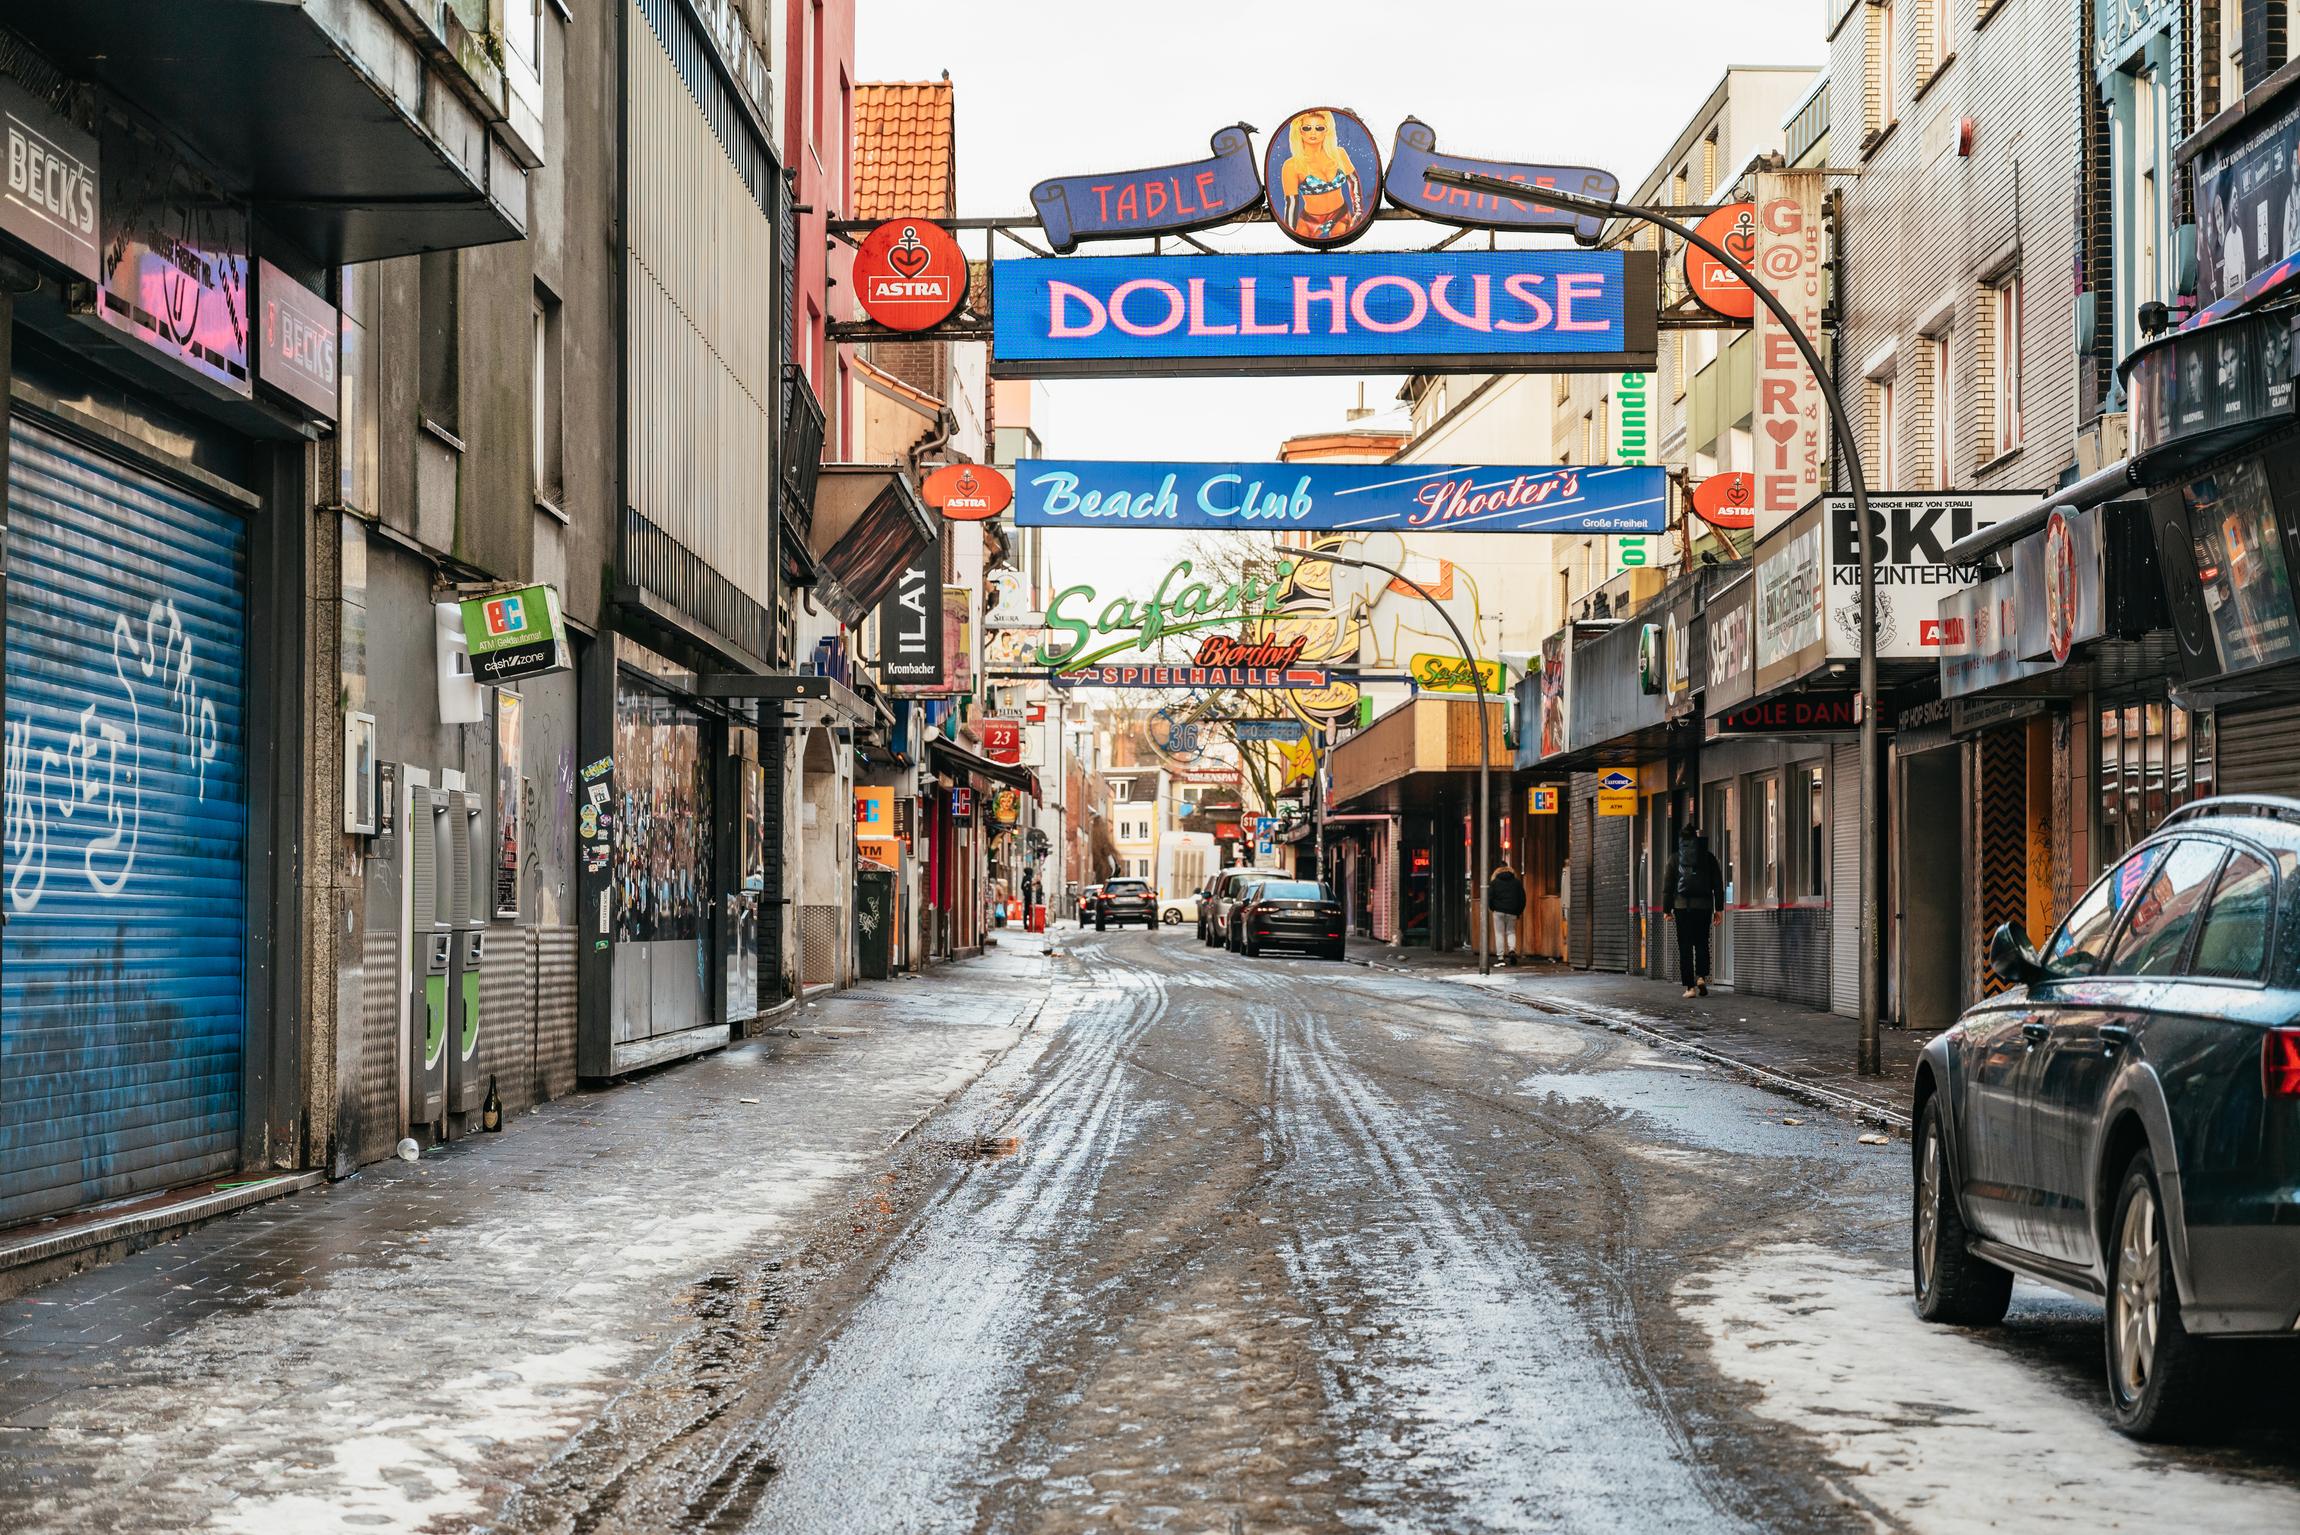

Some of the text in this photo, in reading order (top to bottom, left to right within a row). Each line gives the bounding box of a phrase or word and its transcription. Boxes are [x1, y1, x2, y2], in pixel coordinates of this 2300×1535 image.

[8, 128, 95, 235] BECK'S
[1091, 171, 1225, 223] TABLE
[1803, 226, 1818, 297] CLUB
[874, 281, 943, 297] ASTRA
[1047, 273, 1611, 339] DOLLHOUSE
[281, 310, 335, 385] BECK'S
[2268, 382, 2292, 396] YELLOW
[1804, 403, 1818, 421] &
[2271, 396, 2289, 408] CLAW
[1803, 431, 1818, 484] BAR
[947, 498, 987, 508] ASTRA
[1031, 470, 1313, 522] Beach Club
[1582, 518, 1649, 529] Große Freiheit
[899, 566, 927, 654] ILAY
[1035, 558, 1294, 667] Safari
[479, 631, 543, 651] ATM Geldautomat
[1194, 632, 1308, 674] Bierdorf
[888, 661, 935, 675] Krombacher
[1102, 666, 1281, 686] SPIELHALLE
[1728, 703, 1788, 727] OLE
[1910, 705, 1924, 728] HOP
[1924, 698, 1945, 725] SINCE
[992, 731, 1011, 745] 23
[1169, 723, 1198, 752] 36
[1293, 748, 1313, 768] 36
[1603, 777, 1629, 786] Euronet
[1261, 843, 1271, 853] P
